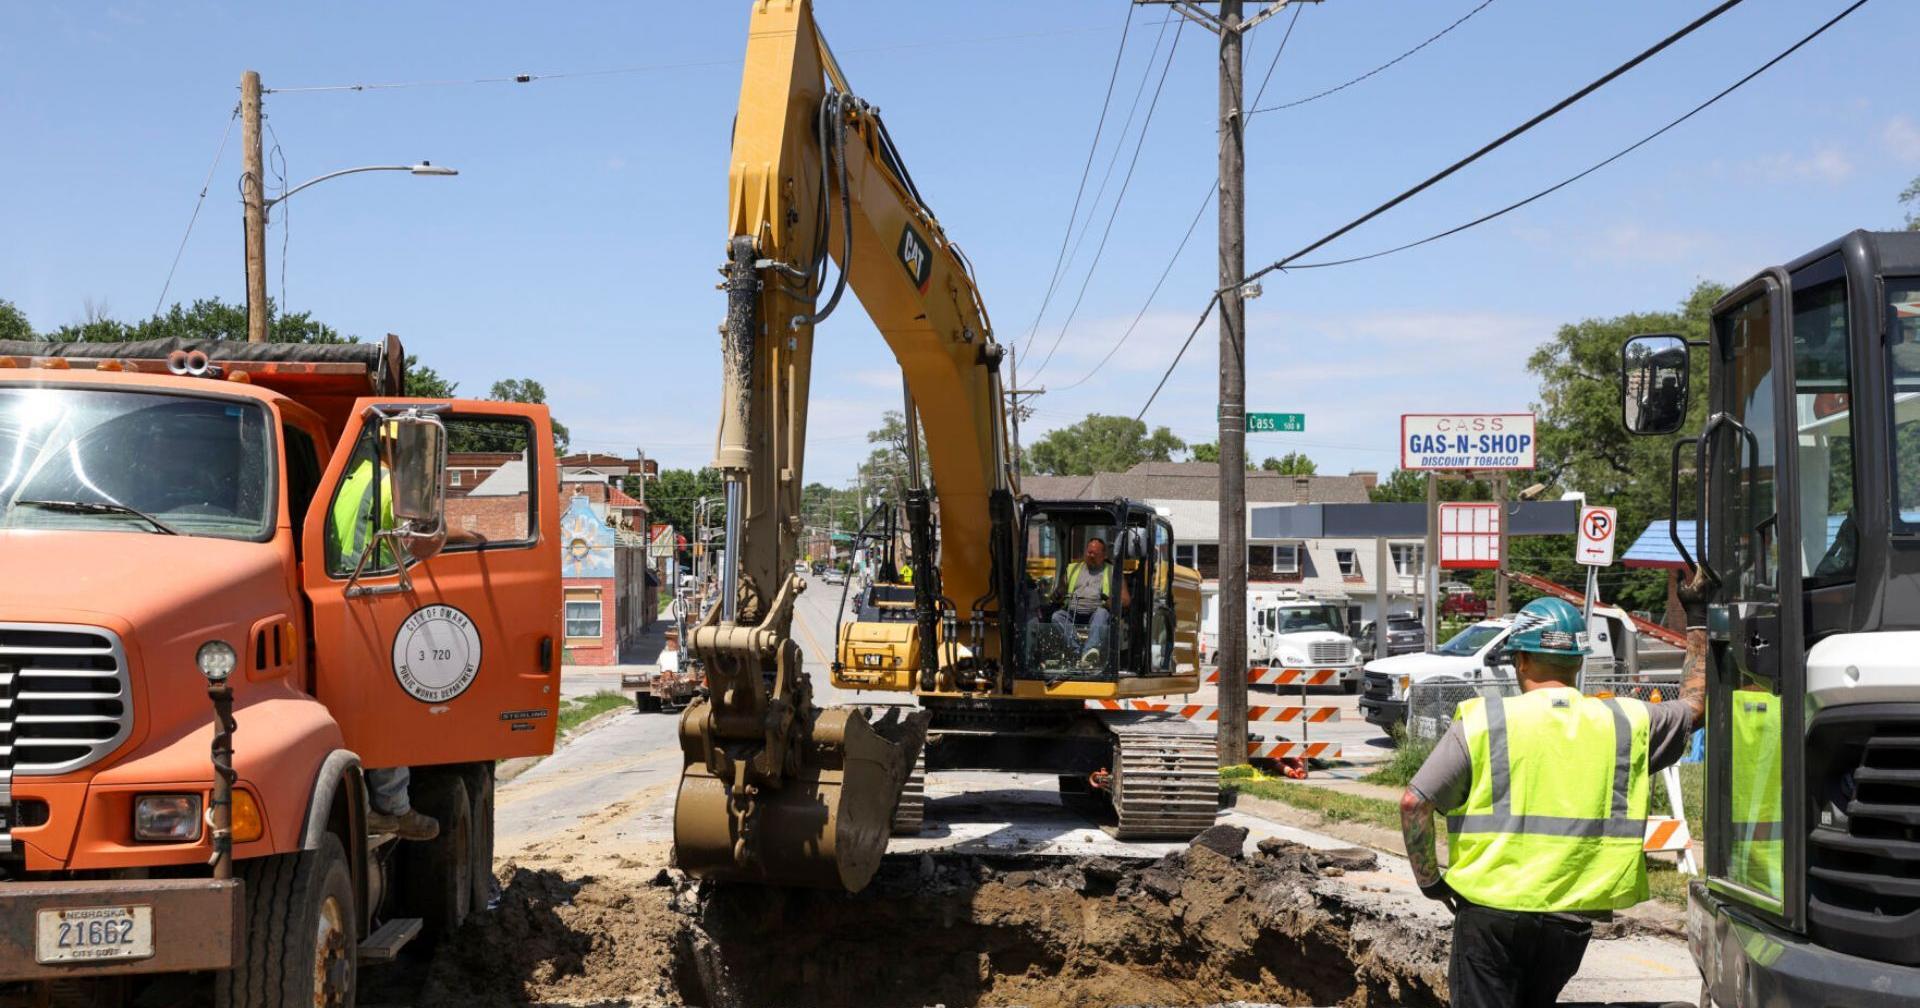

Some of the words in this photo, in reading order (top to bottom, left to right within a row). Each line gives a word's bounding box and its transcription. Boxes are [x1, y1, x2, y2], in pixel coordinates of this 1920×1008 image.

[904, 231, 924, 281] CAT
[1250, 416, 1275, 429] Cass
[1437, 418, 1504, 431] CASS
[1410, 434, 1531, 453] GAS-N-SHOP
[1421, 456, 1471, 466] DISCOUNT
[1474, 456, 1519, 466] TOBACCO
[406, 612, 425, 632] CITY
[426, 608, 437, 618] OF
[439, 608, 468, 630] OMAHA
[418, 650, 425, 661] 3
[432, 649, 451, 660] 720
[399, 665, 416, 689] PUBLIC
[415, 686, 438, 699] WORKS
[440, 663, 475, 699] DEPARTMENT
[502, 710, 548, 719] STERLING
[66, 910, 126, 920] NEBRASKA
[58, 919, 134, 948] 21662
[72, 950, 93, 958] CITY
